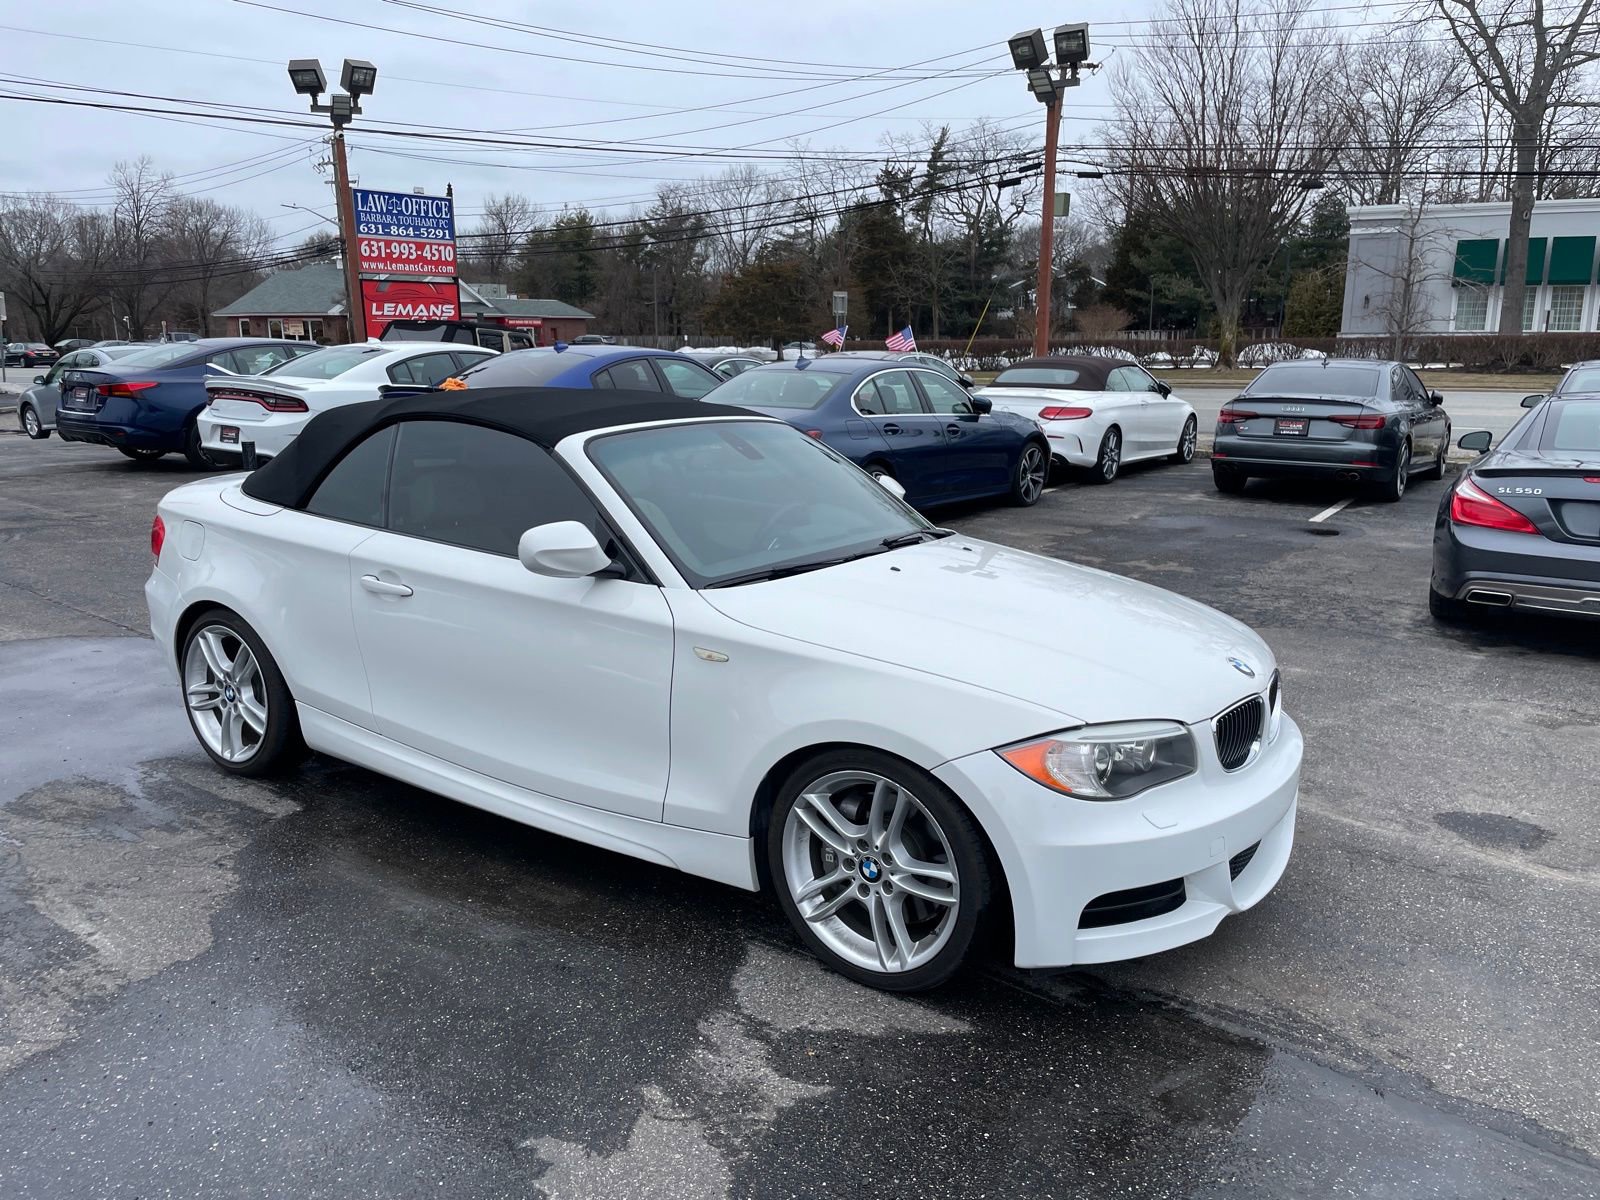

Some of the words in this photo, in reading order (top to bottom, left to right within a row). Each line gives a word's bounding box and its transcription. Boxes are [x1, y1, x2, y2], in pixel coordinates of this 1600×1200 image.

[356, 193, 388, 213] LAW
[401, 197, 450, 218] OFFICE
[360, 213, 398, 224] BARBARA
[398, 216, 437, 228] TOUHAMY
[439, 219, 449, 228] PC
[360, 223, 450, 239] 631-864-5291
[360, 241, 454, 261] 631-993-4510
[362, 261, 454, 273] www.LemansCars.com
[371, 303, 455, 317] LEMANS
[1515, 487, 1542, 495] 550
